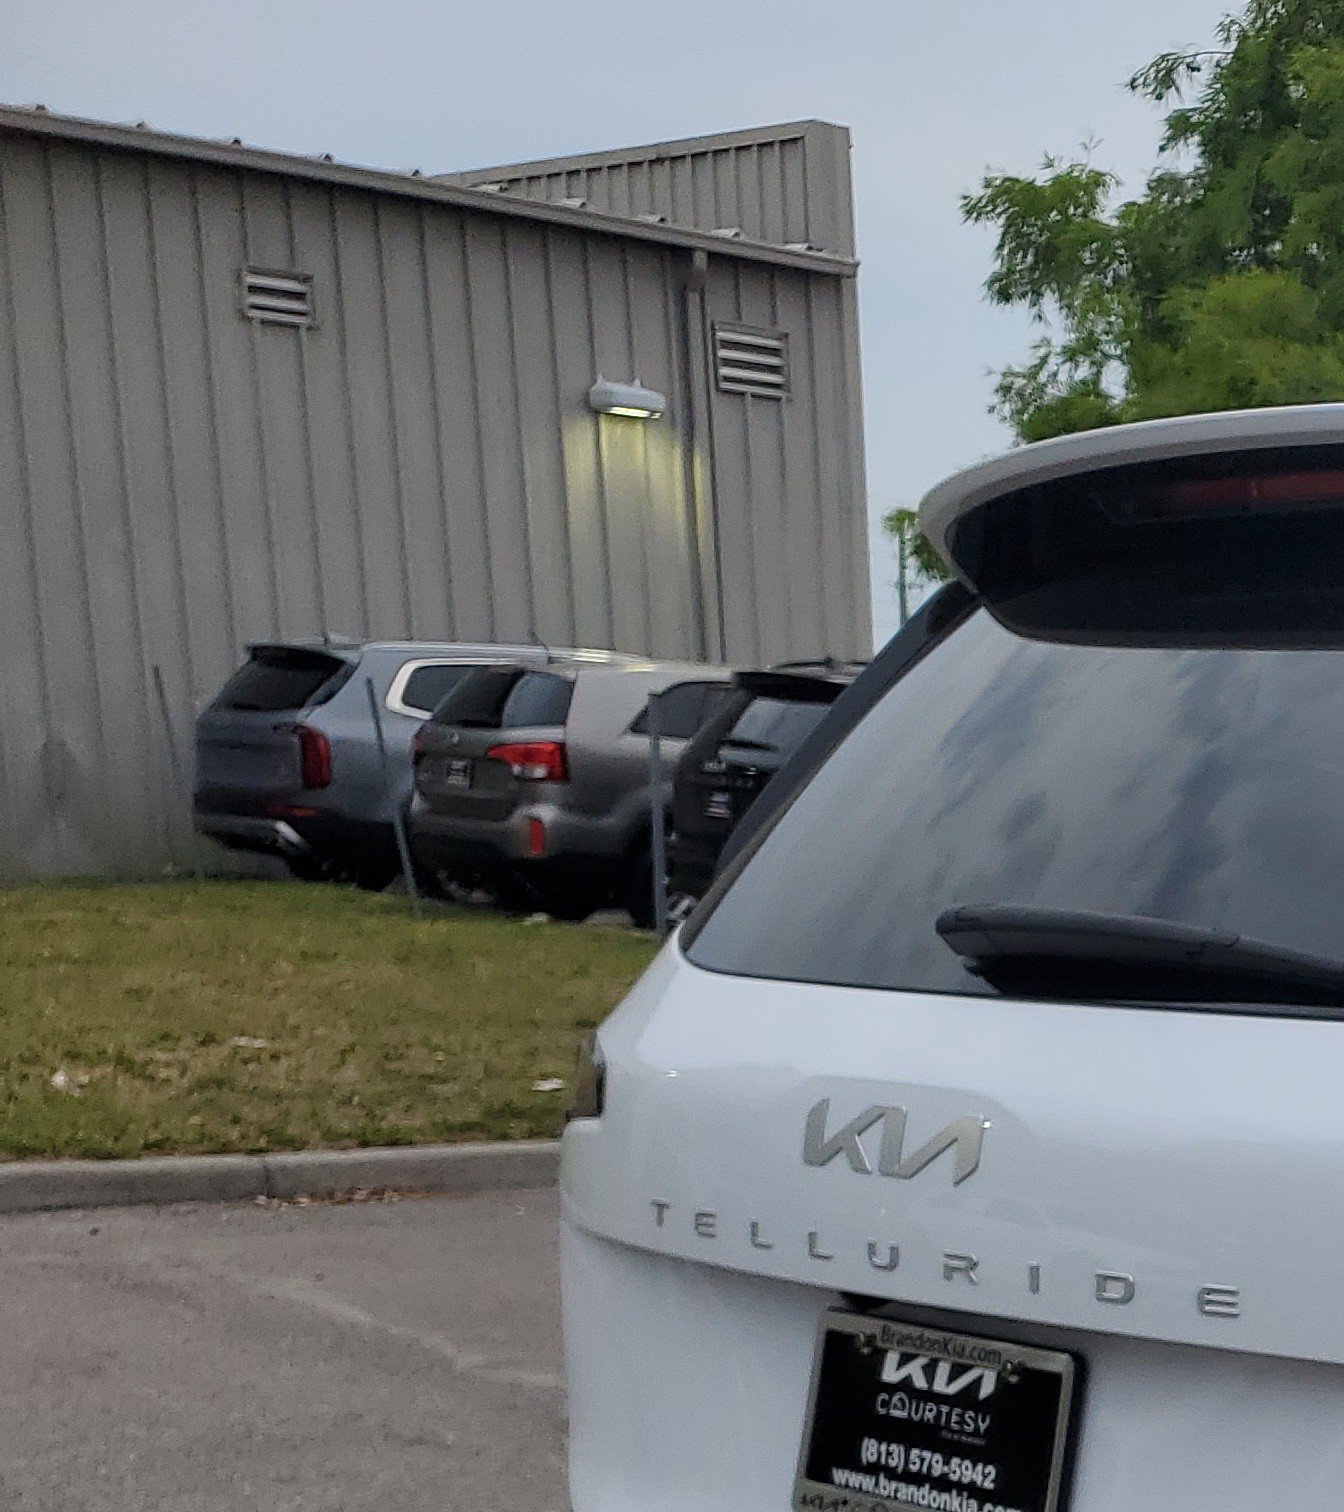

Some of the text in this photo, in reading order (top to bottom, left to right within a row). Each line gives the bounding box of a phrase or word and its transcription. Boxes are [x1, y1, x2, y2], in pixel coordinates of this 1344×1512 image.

[803, 1098, 985, 1187] KIA
[651, 1198, 1241, 1318] TELLURIDE
[875, 1392, 992, 1436] COURTESY
[860, 1437, 906, 1474] (813)
[908, 1447, 997, 1491] 579-5942
